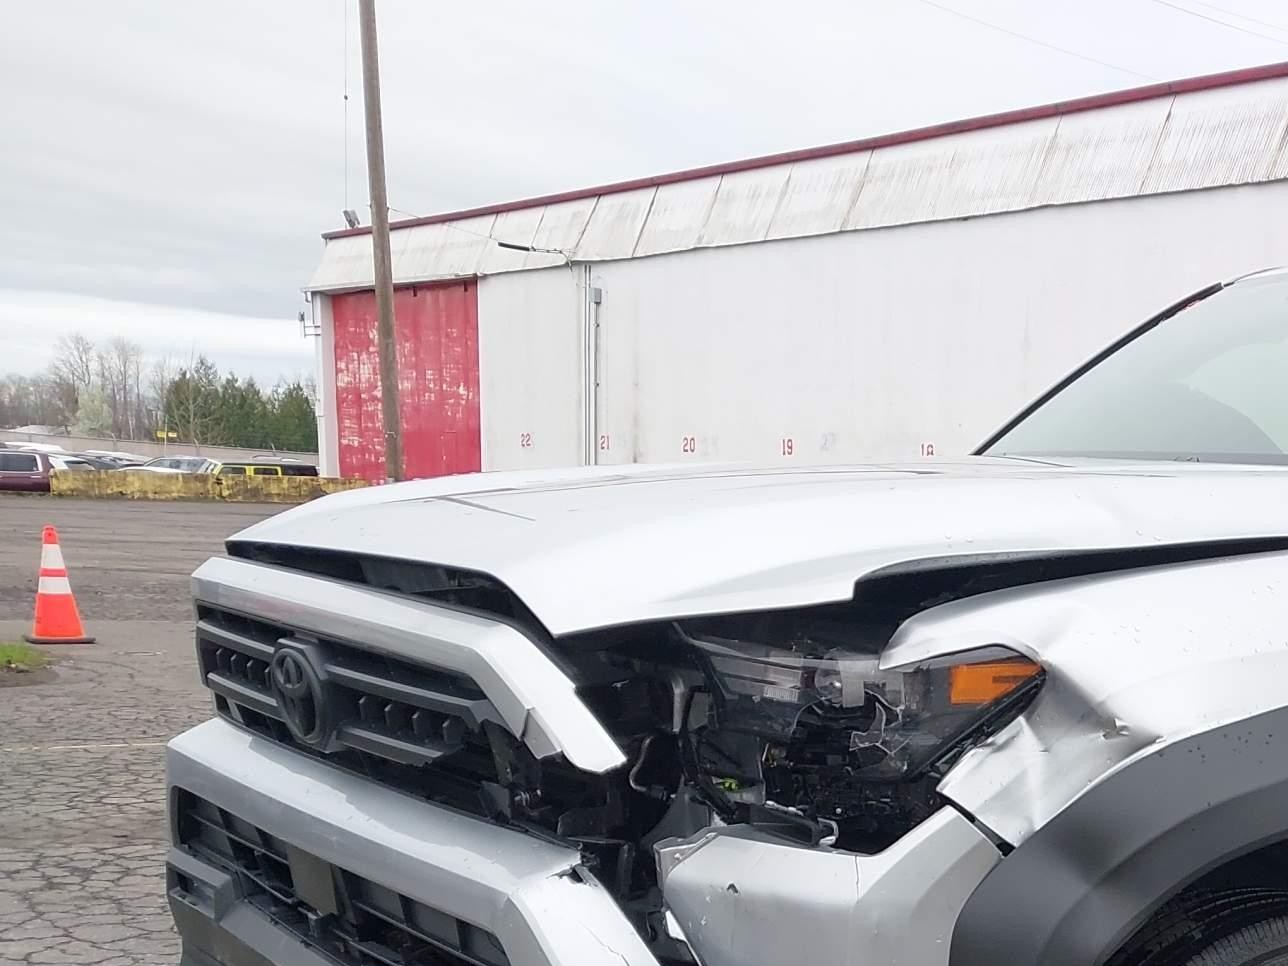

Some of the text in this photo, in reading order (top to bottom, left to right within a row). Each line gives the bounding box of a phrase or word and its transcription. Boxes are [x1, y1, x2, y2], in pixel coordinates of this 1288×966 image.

[520, 432, 533, 449] 22
[600, 435, 611, 451] 21
[682, 436, 697, 454] 20
[782, 438, 794, 457] 19
